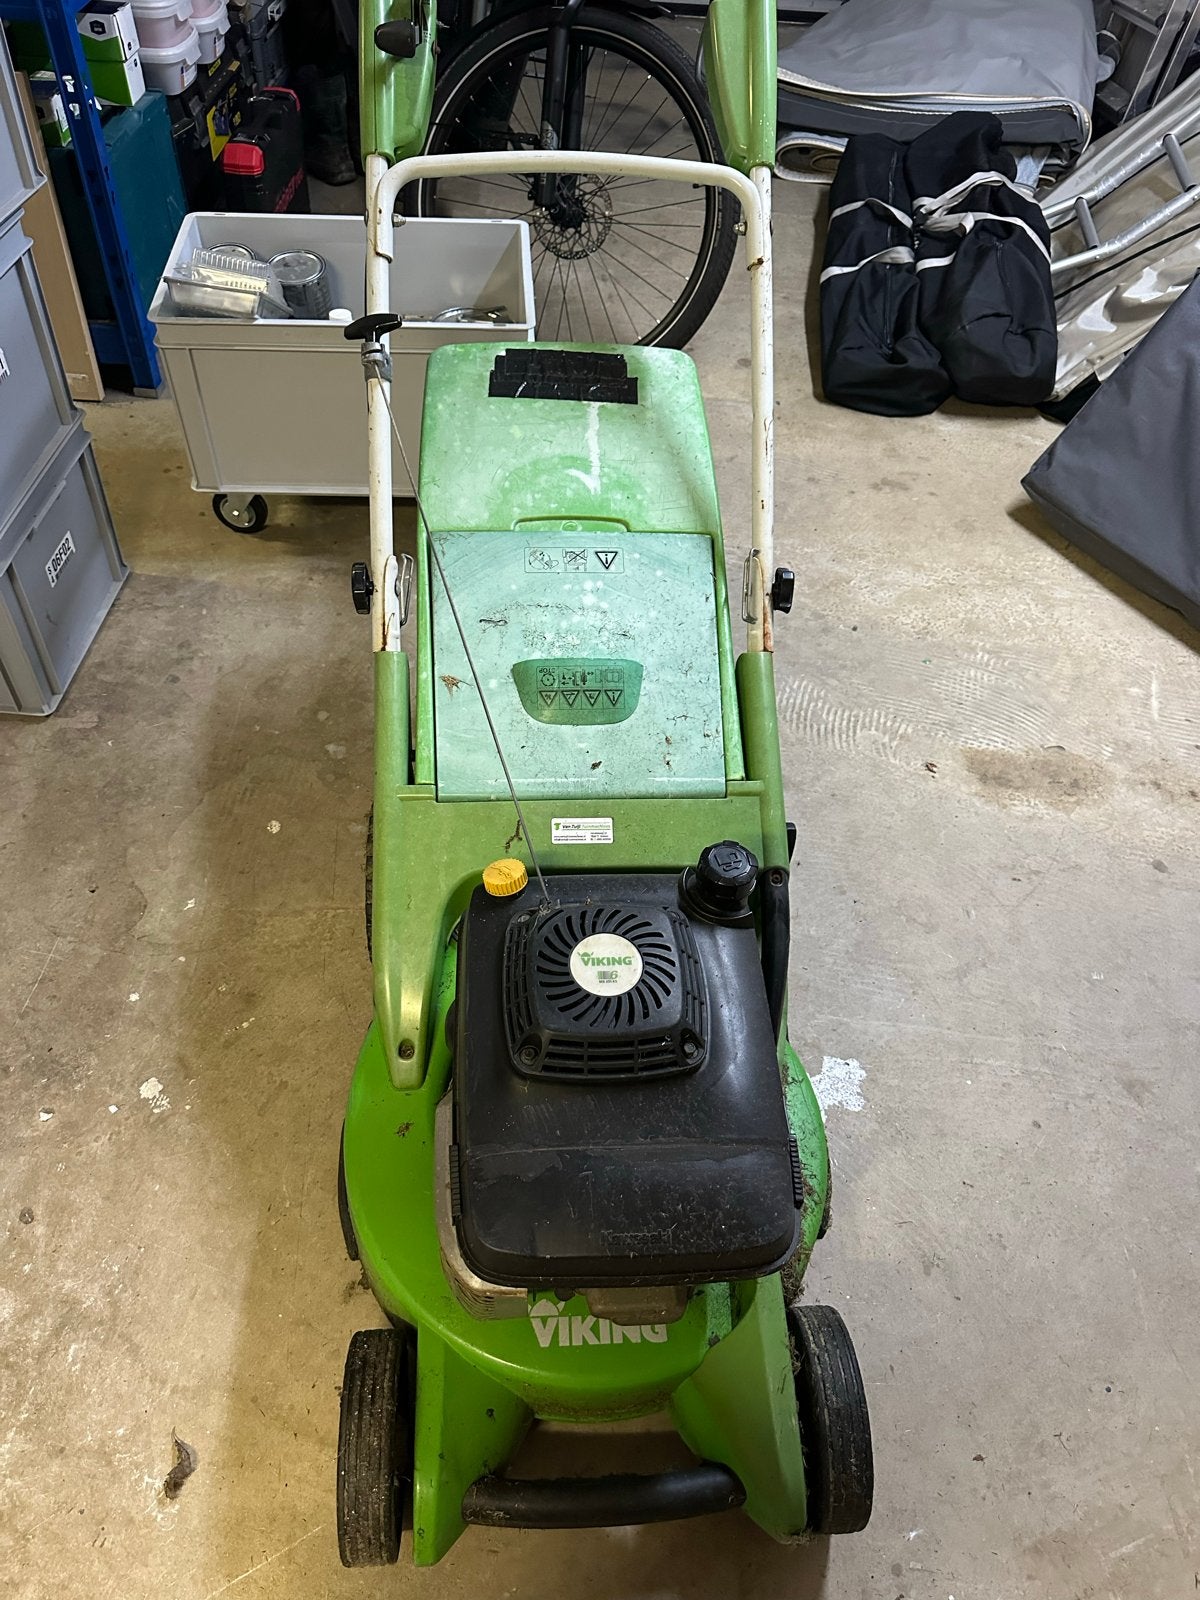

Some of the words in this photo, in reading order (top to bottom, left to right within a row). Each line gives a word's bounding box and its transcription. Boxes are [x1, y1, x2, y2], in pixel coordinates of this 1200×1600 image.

[51, 537, 71, 572] 06F02
[580, 956, 633, 967] VIKING
[529, 1315, 668, 1348] VIKING
